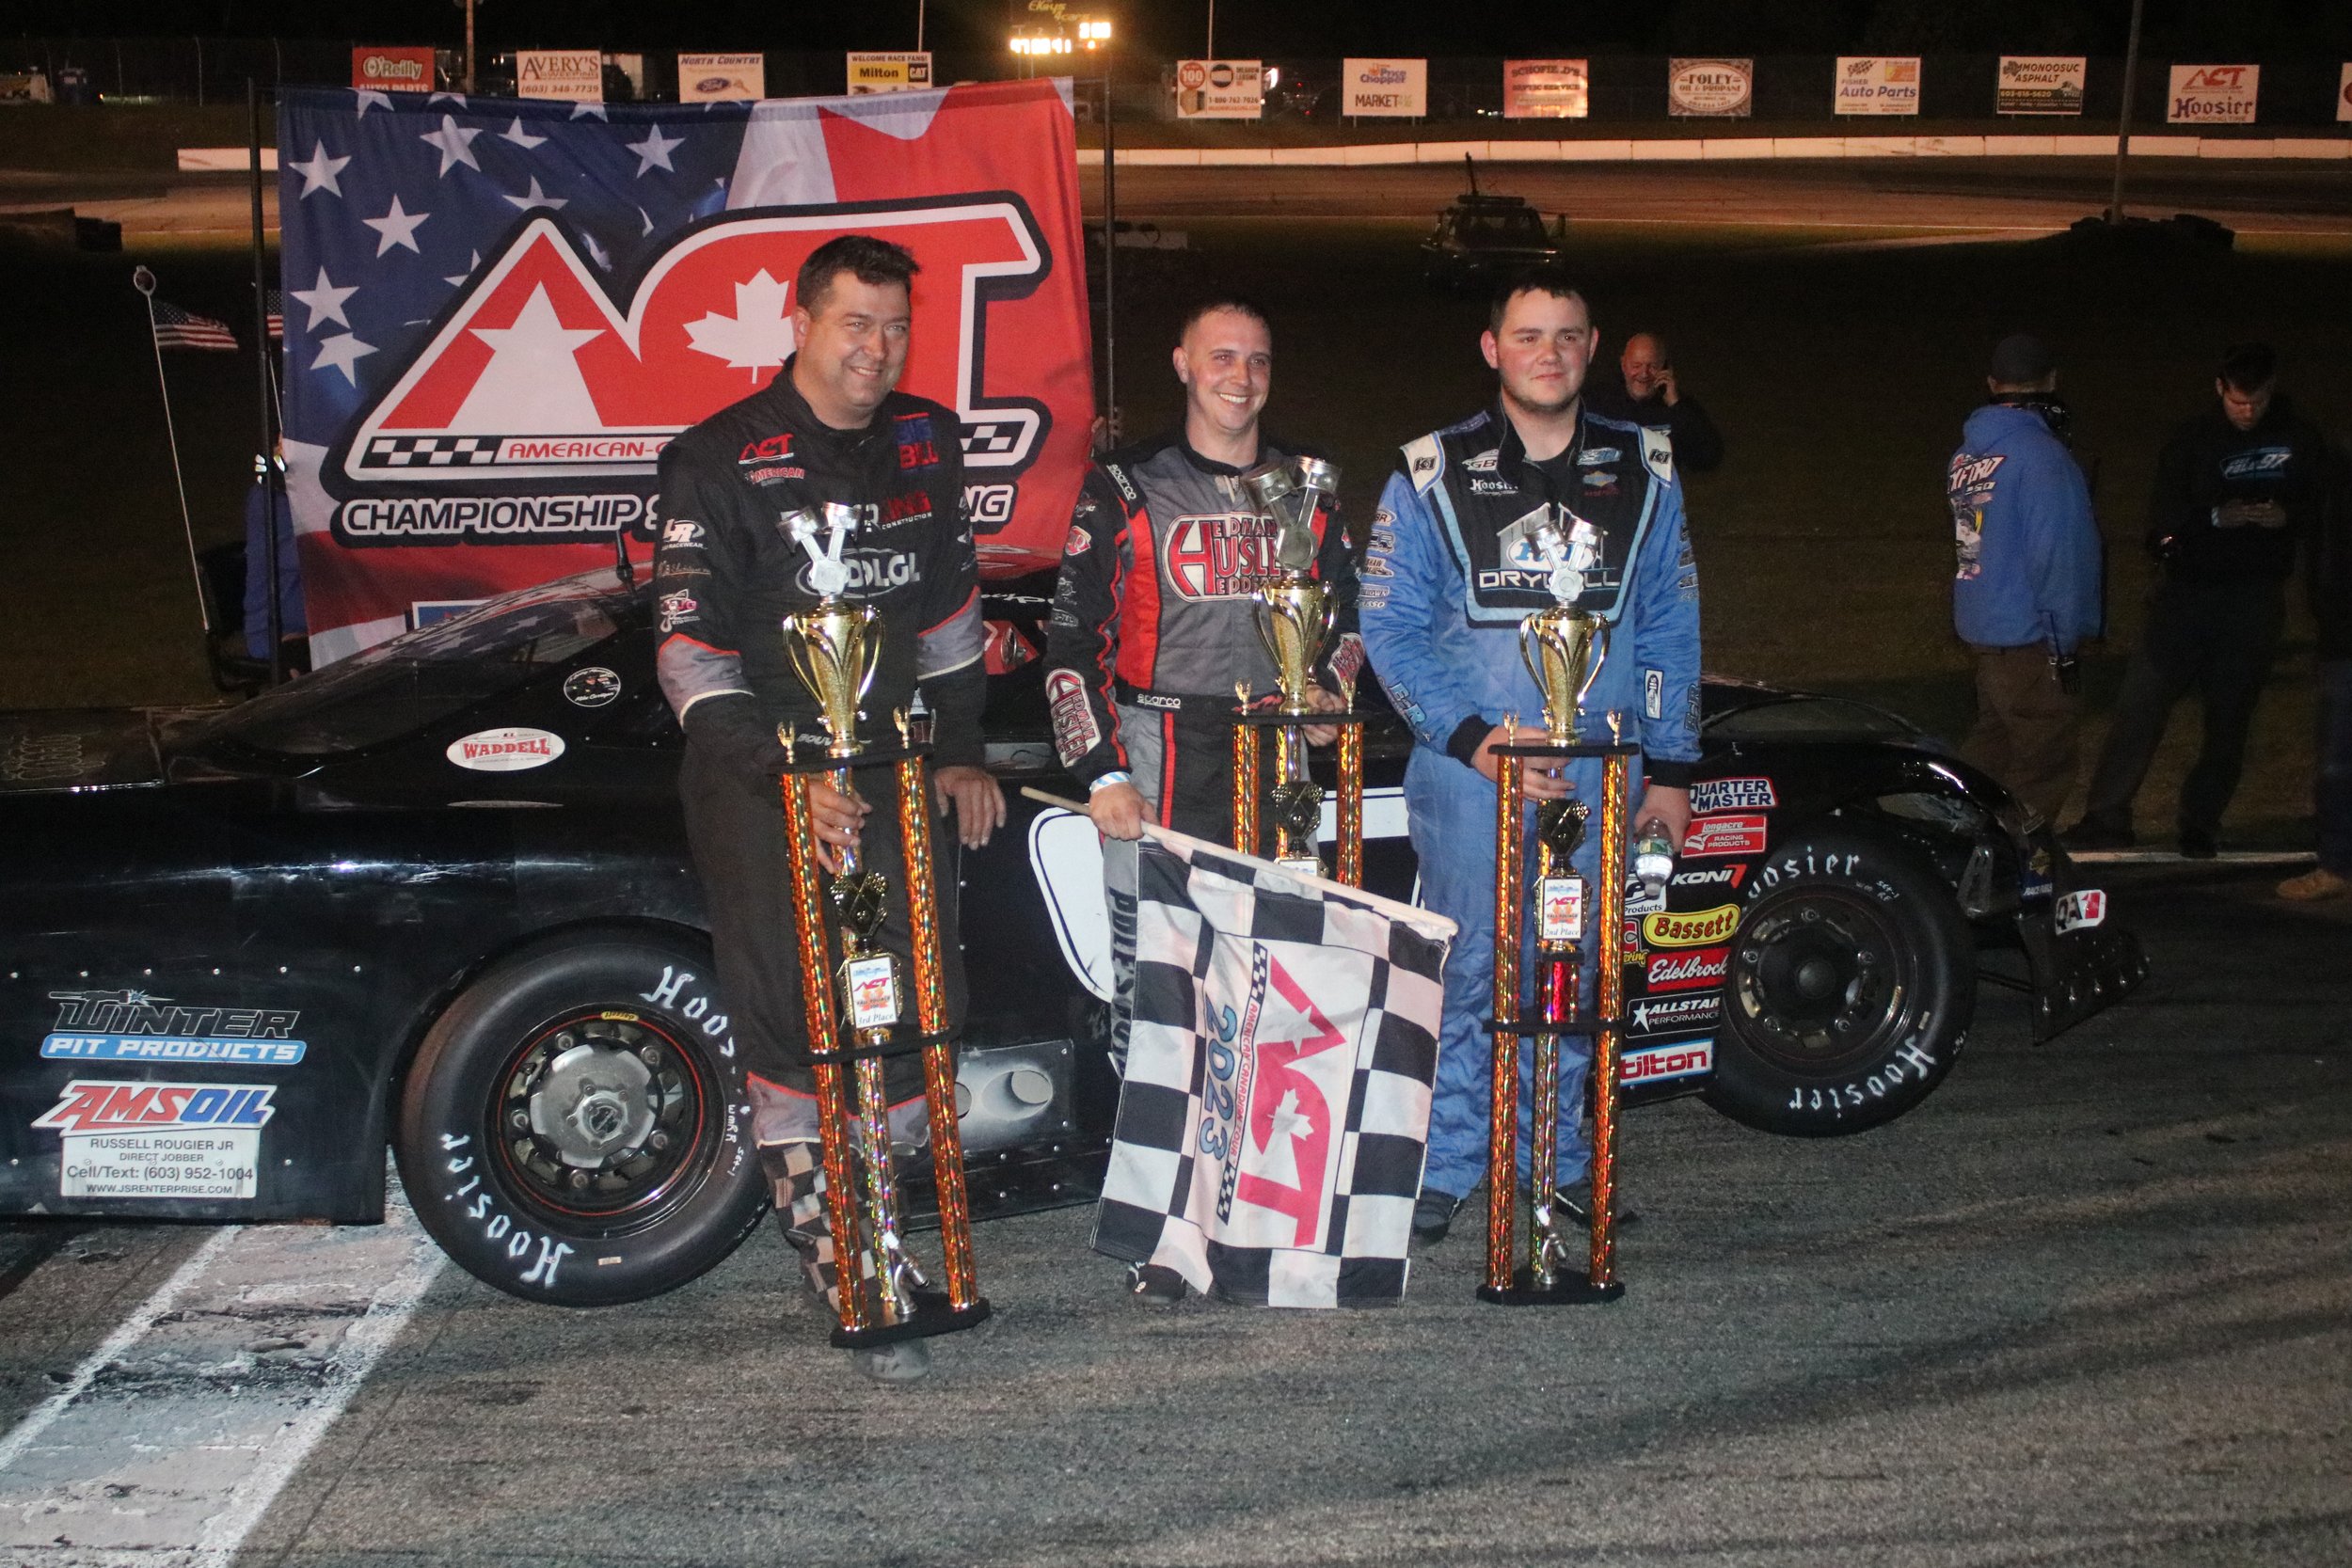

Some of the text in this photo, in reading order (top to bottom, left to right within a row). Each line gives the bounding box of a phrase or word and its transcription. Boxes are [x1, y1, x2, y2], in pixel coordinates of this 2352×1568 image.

[363, 55, 422, 79] O'Reilly
[521, 56, 598, 80] AVERY'S
[859, 68, 899, 77] Milton
[1183, 70, 1204, 83] 100
[2183, 67, 2246, 89] ACT
[1360, 74, 1406, 85] Chopper
[2014, 74, 2060, 83] ASPHALT
[1839, 86, 1916, 98] Auto Parts
[2170, 96, 2253, 119] Hoosier
[739, 434, 794, 461] ACT
[1109, 464, 1136, 500] sparco
[345, 498, 638, 531] CHAMPIONSHIP
[1479, 570, 1620, 589] DRYLL
[463, 736, 551, 759] WADDELL
[1697, 793, 1772, 812] MASTER
[1703, 821, 1743, 832] Longacre
[1708, 840, 1751, 848] PRODUCTS
[1671, 871, 1731, 886] KONI
[1747, 846, 1860, 899] oosier
[2057, 891, 2101, 930] QA1
[1544, 927, 1581, 937] 2nd Place
[1654, 913, 1734, 939] Bassett
[1648, 955, 1728, 984] Edelbrock
[1648, 996, 1720, 1015] ALLSTAR
[53, 1000, 301, 1039] WINTER
[858, 1013, 895, 1025] 3rd Place
[1648, 1010, 1720, 1025] PERFORMANCE
[48, 1038, 299, 1061] PIT PRODUCTS
[1199, 993, 1238, 1161] 2023
[1230, 1002, 1259, 1162] AMERICAN CANADIAN TOUR
[1788, 1034, 1936, 1120] Hoosier
[48, 1085, 269, 1130] AMSOIL
[1236, 954, 1347, 1247] ACT
[90, 1138, 234, 1151] RUSSELL ROUGIER JR
[119, 1152, 204, 1164] DIRECT JOBBER
[67, 1166, 254, 1182] Cell/Text: (603) 952-1004
[87, 1183, 232, 1195] WWW.JSRENTERPRISE.COM
[440, 1132, 575, 1288] Hoosier
